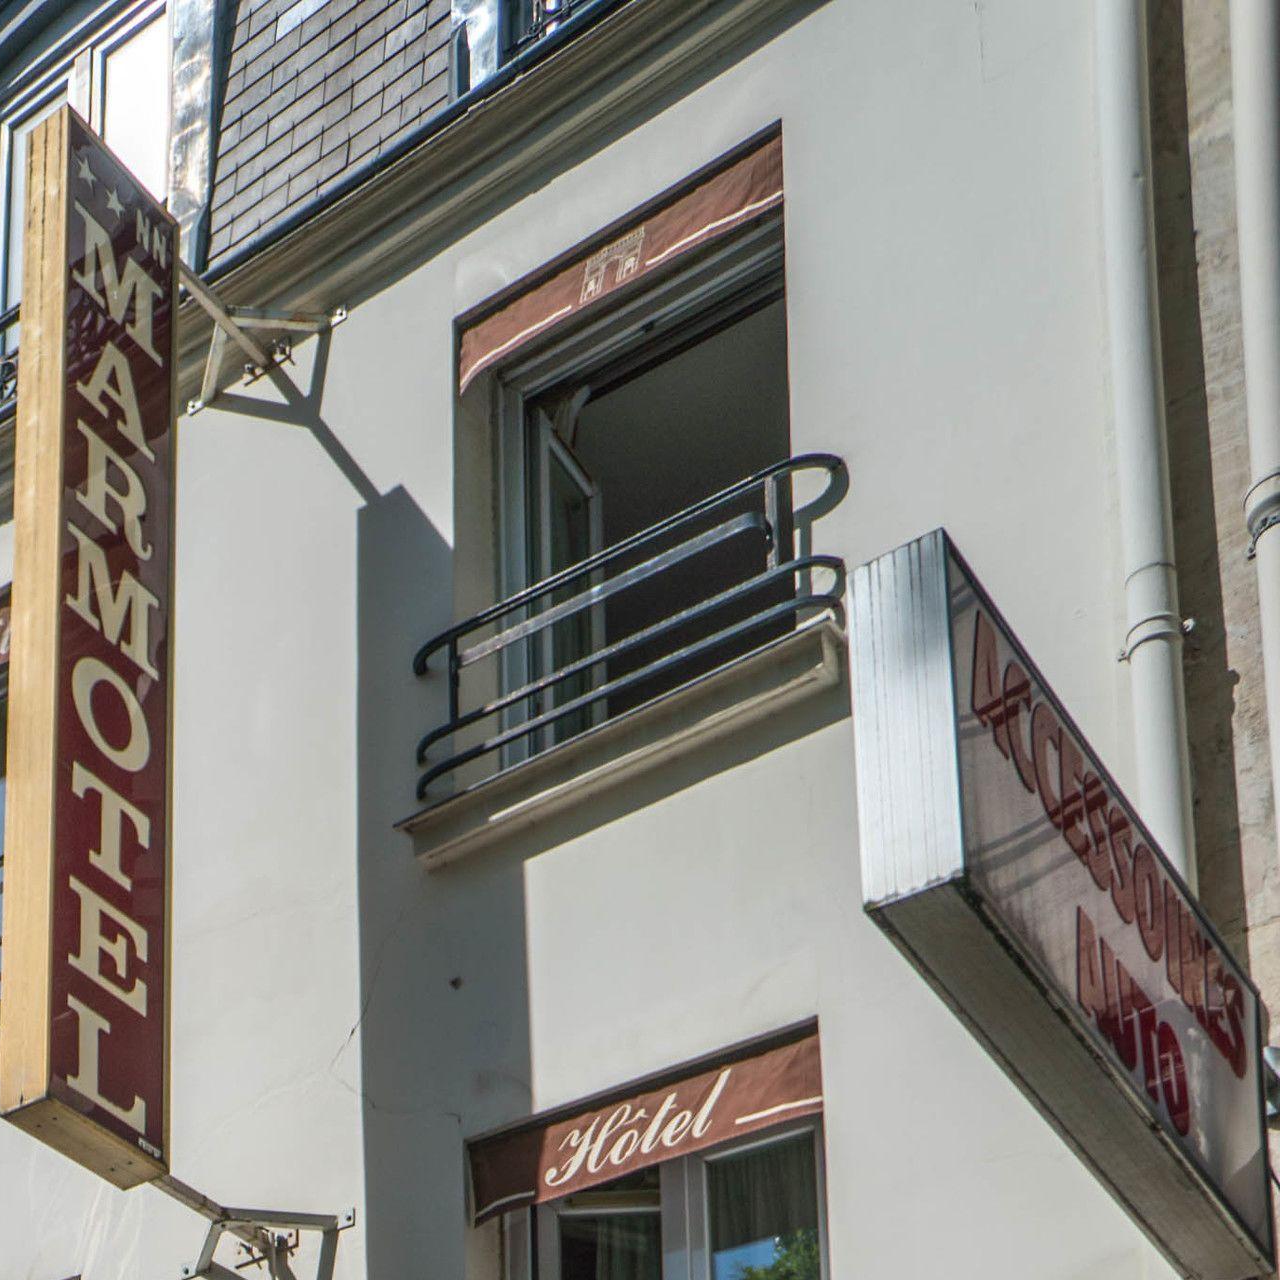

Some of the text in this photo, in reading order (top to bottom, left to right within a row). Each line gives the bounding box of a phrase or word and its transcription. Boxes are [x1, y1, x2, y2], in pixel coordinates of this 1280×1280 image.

[136, 206, 167, 271] NN
[64, 200, 165, 1138] MARMOTEL
[971, 608, 1248, 1080] ACCESSOIRES
[543, 1067, 732, 1187] Hôtel
[1075, 902, 1191, 1138] AUTO
